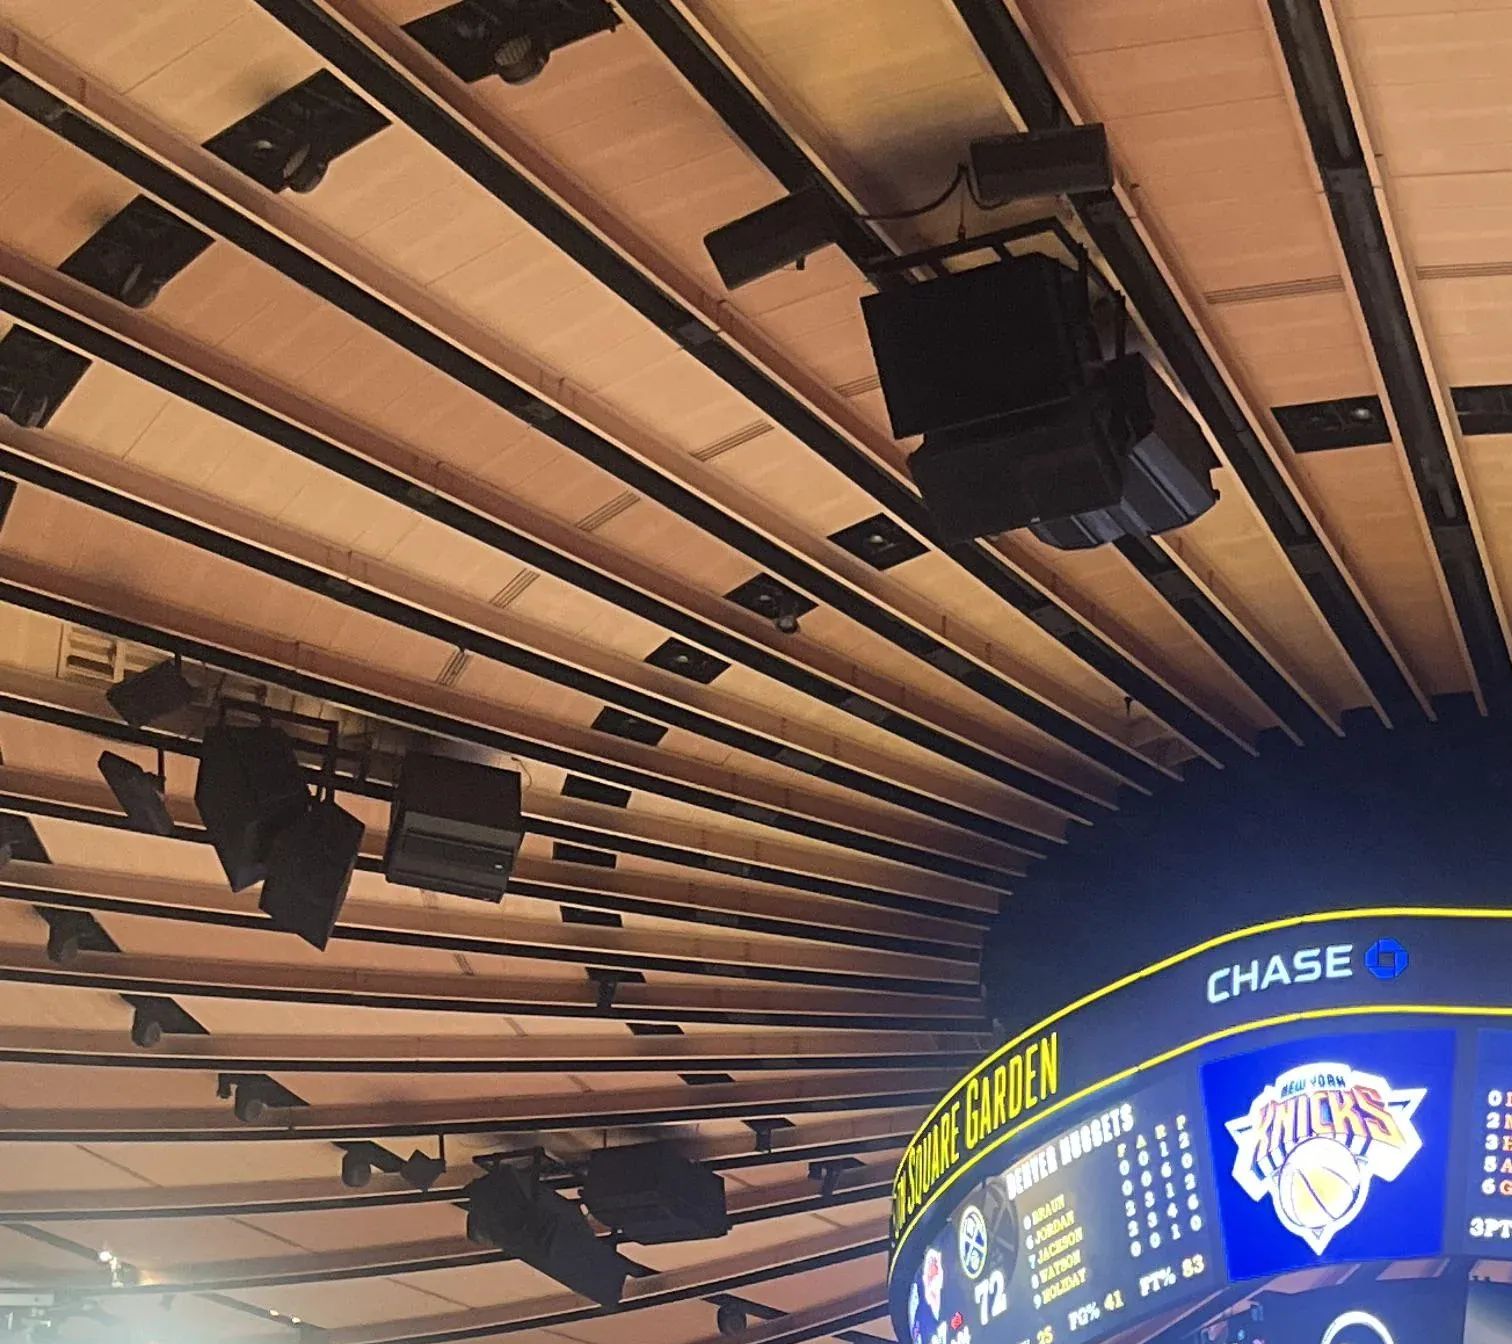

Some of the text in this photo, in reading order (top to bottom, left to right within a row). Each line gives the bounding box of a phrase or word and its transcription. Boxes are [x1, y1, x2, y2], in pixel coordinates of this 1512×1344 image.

[1207, 945, 1353, 1004] CHASE
[1488, 1089, 1502, 1106] 0
[907, 1100, 960, 1216] SQUARE
[966, 1032, 1058, 1149] GARDEN
[1250, 1085, 1406, 1178] KNICKS
[1486, 1112, 1500, 1129] 2
[1005, 1103, 1134, 1200] DENVER NUGGETS
[1485, 1134, 1498, 1150] 3
[1484, 1156, 1497, 1172] 5
[1481, 1178, 1496, 1194] 6
[1139, 1254, 1204, 1297] FT% 83
[974, 1270, 1007, 1325] 72
[1104, 1289, 1124, 1312] 41
